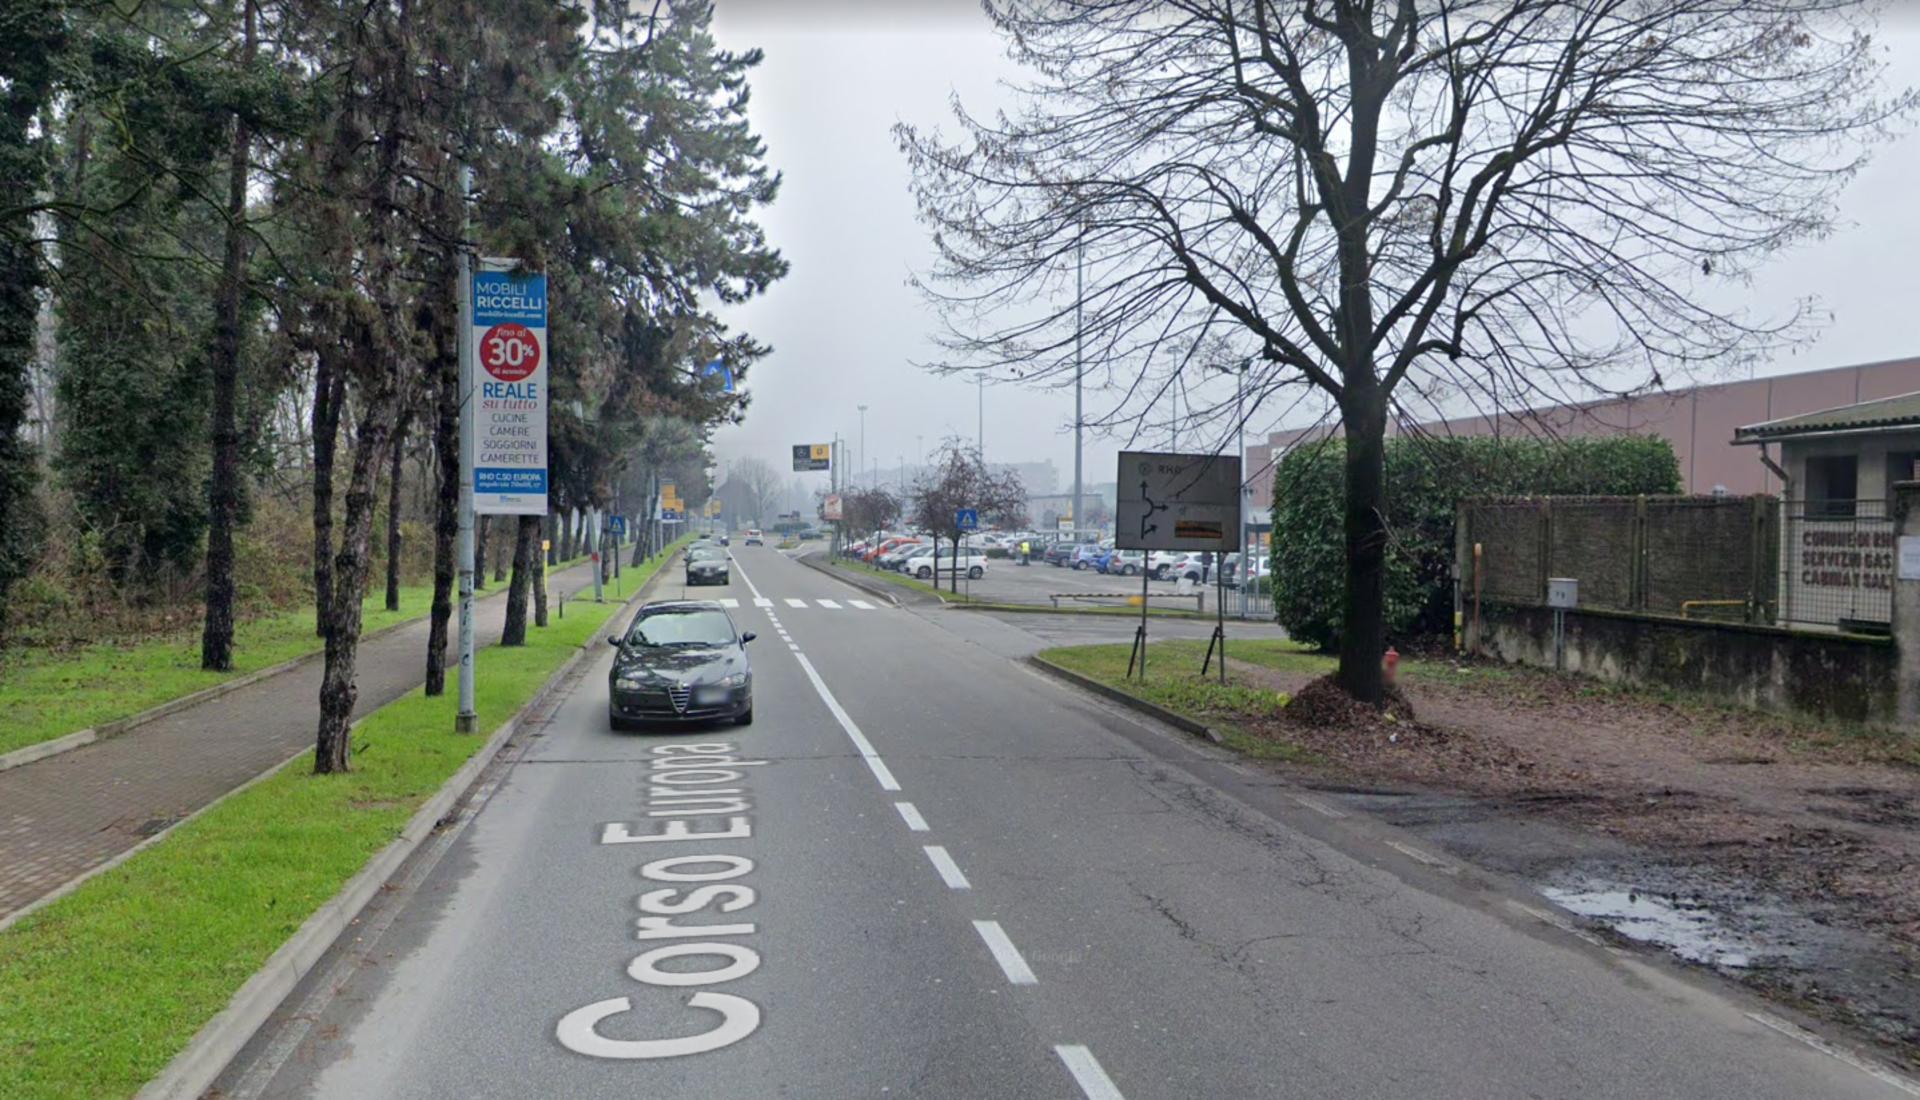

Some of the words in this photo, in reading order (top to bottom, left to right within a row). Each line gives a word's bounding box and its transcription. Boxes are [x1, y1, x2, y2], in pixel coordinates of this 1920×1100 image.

[476, 282, 526, 296] MOBILI
[477, 296, 542, 309] RICCELLI
[488, 337, 535, 366] 30%
[483, 382, 538, 399] REALE
[482, 400, 499, 410] su
[502, 399, 537, 410] tutto
[491, 412, 529, 423] CUCINE
[489, 426, 529, 437] CAMERE
[483, 440, 537, 450] SOGGIORNI
[480, 453, 539, 464] CAMERETTE
[1873, 531, 1893, 548] RH
